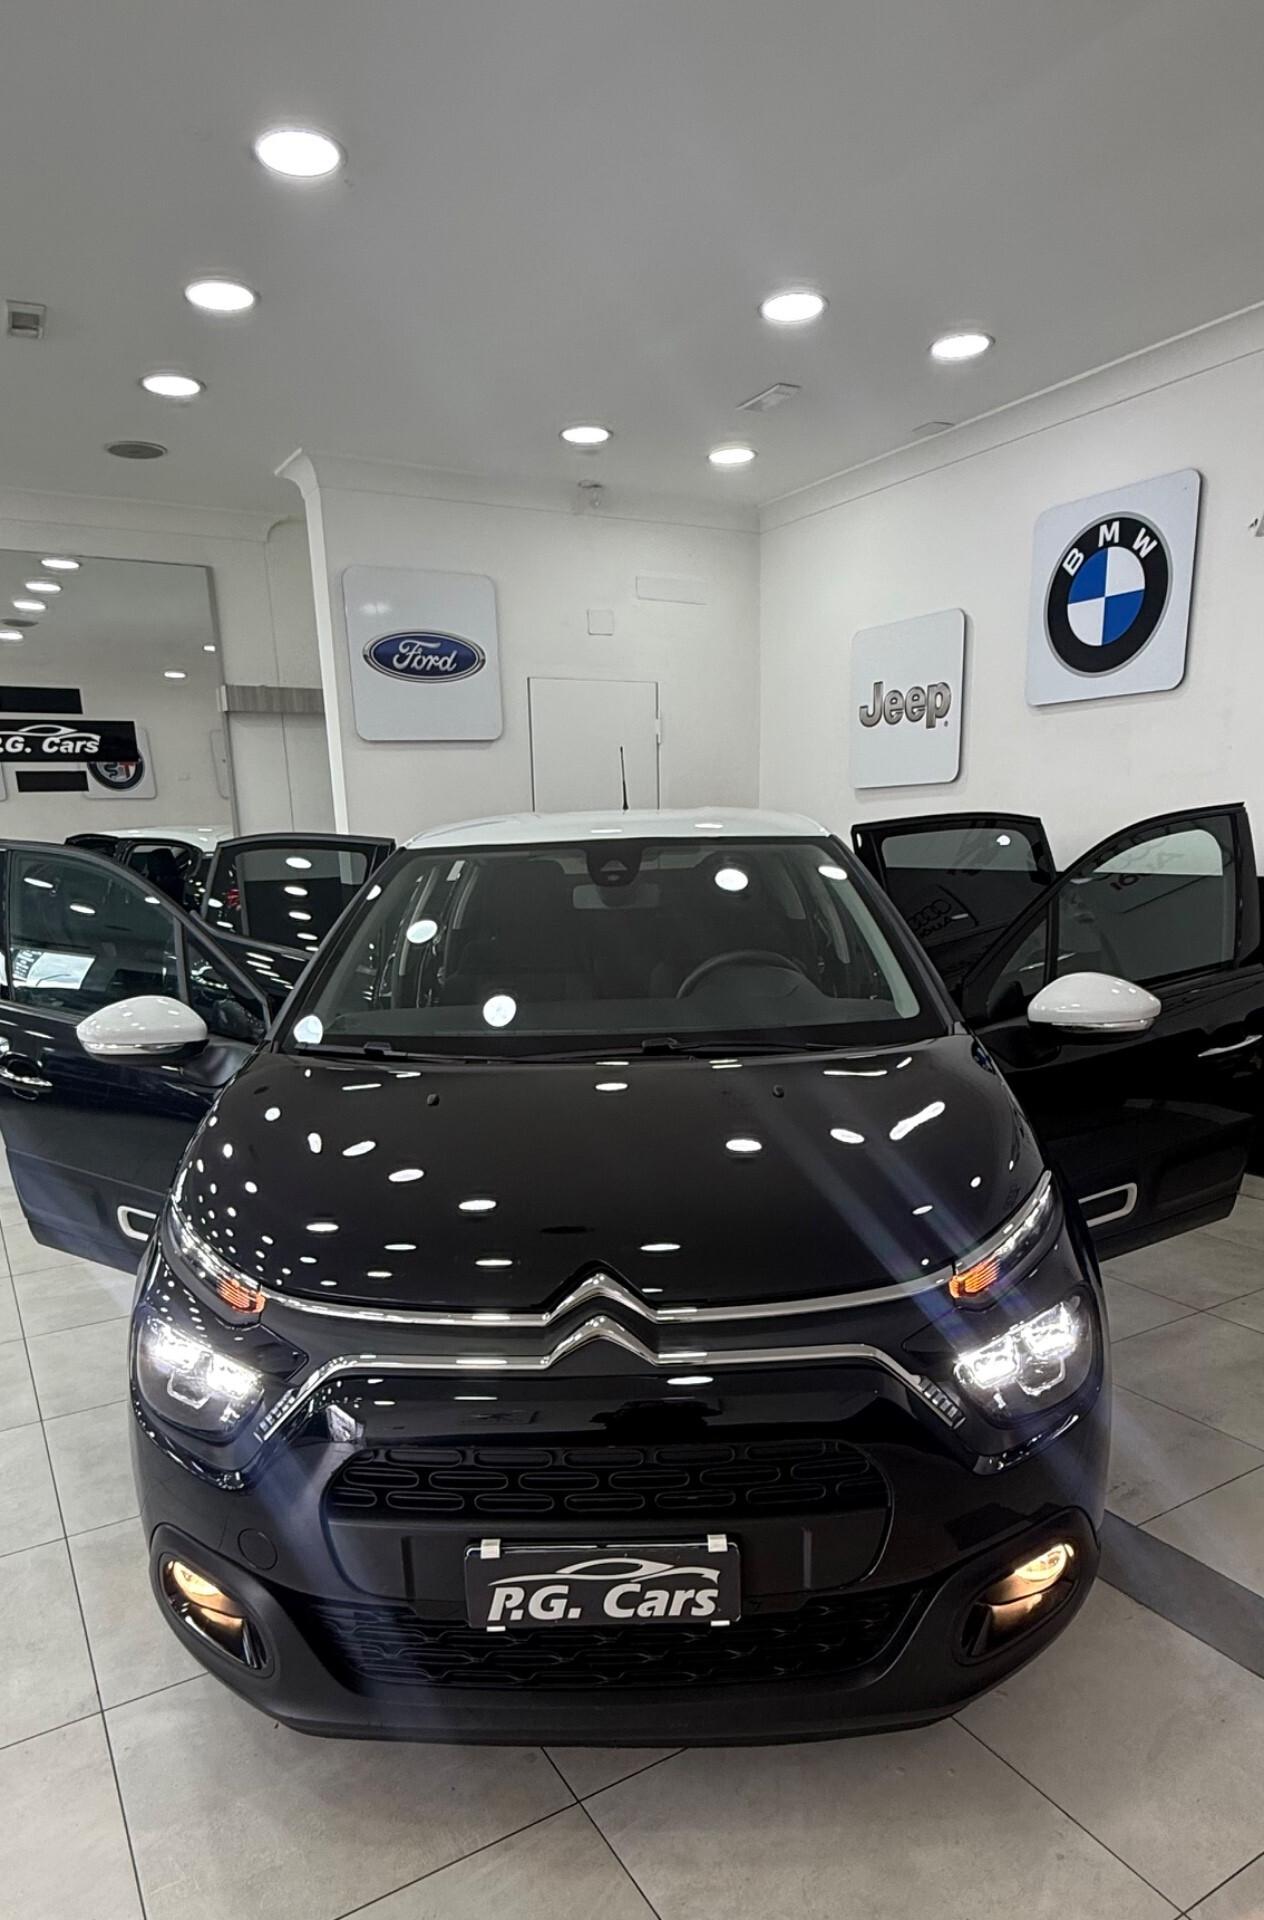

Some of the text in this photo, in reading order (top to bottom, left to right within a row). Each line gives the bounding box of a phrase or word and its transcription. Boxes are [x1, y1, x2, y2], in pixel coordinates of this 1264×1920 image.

[1061, 519, 1159, 577] BMW
[392, 638, 459, 672] Ford
[858, 680, 952, 729] Jeep
[0, 735, 100, 753] .G. Cars
[487, 1583, 719, 1621] P.G. Cars
